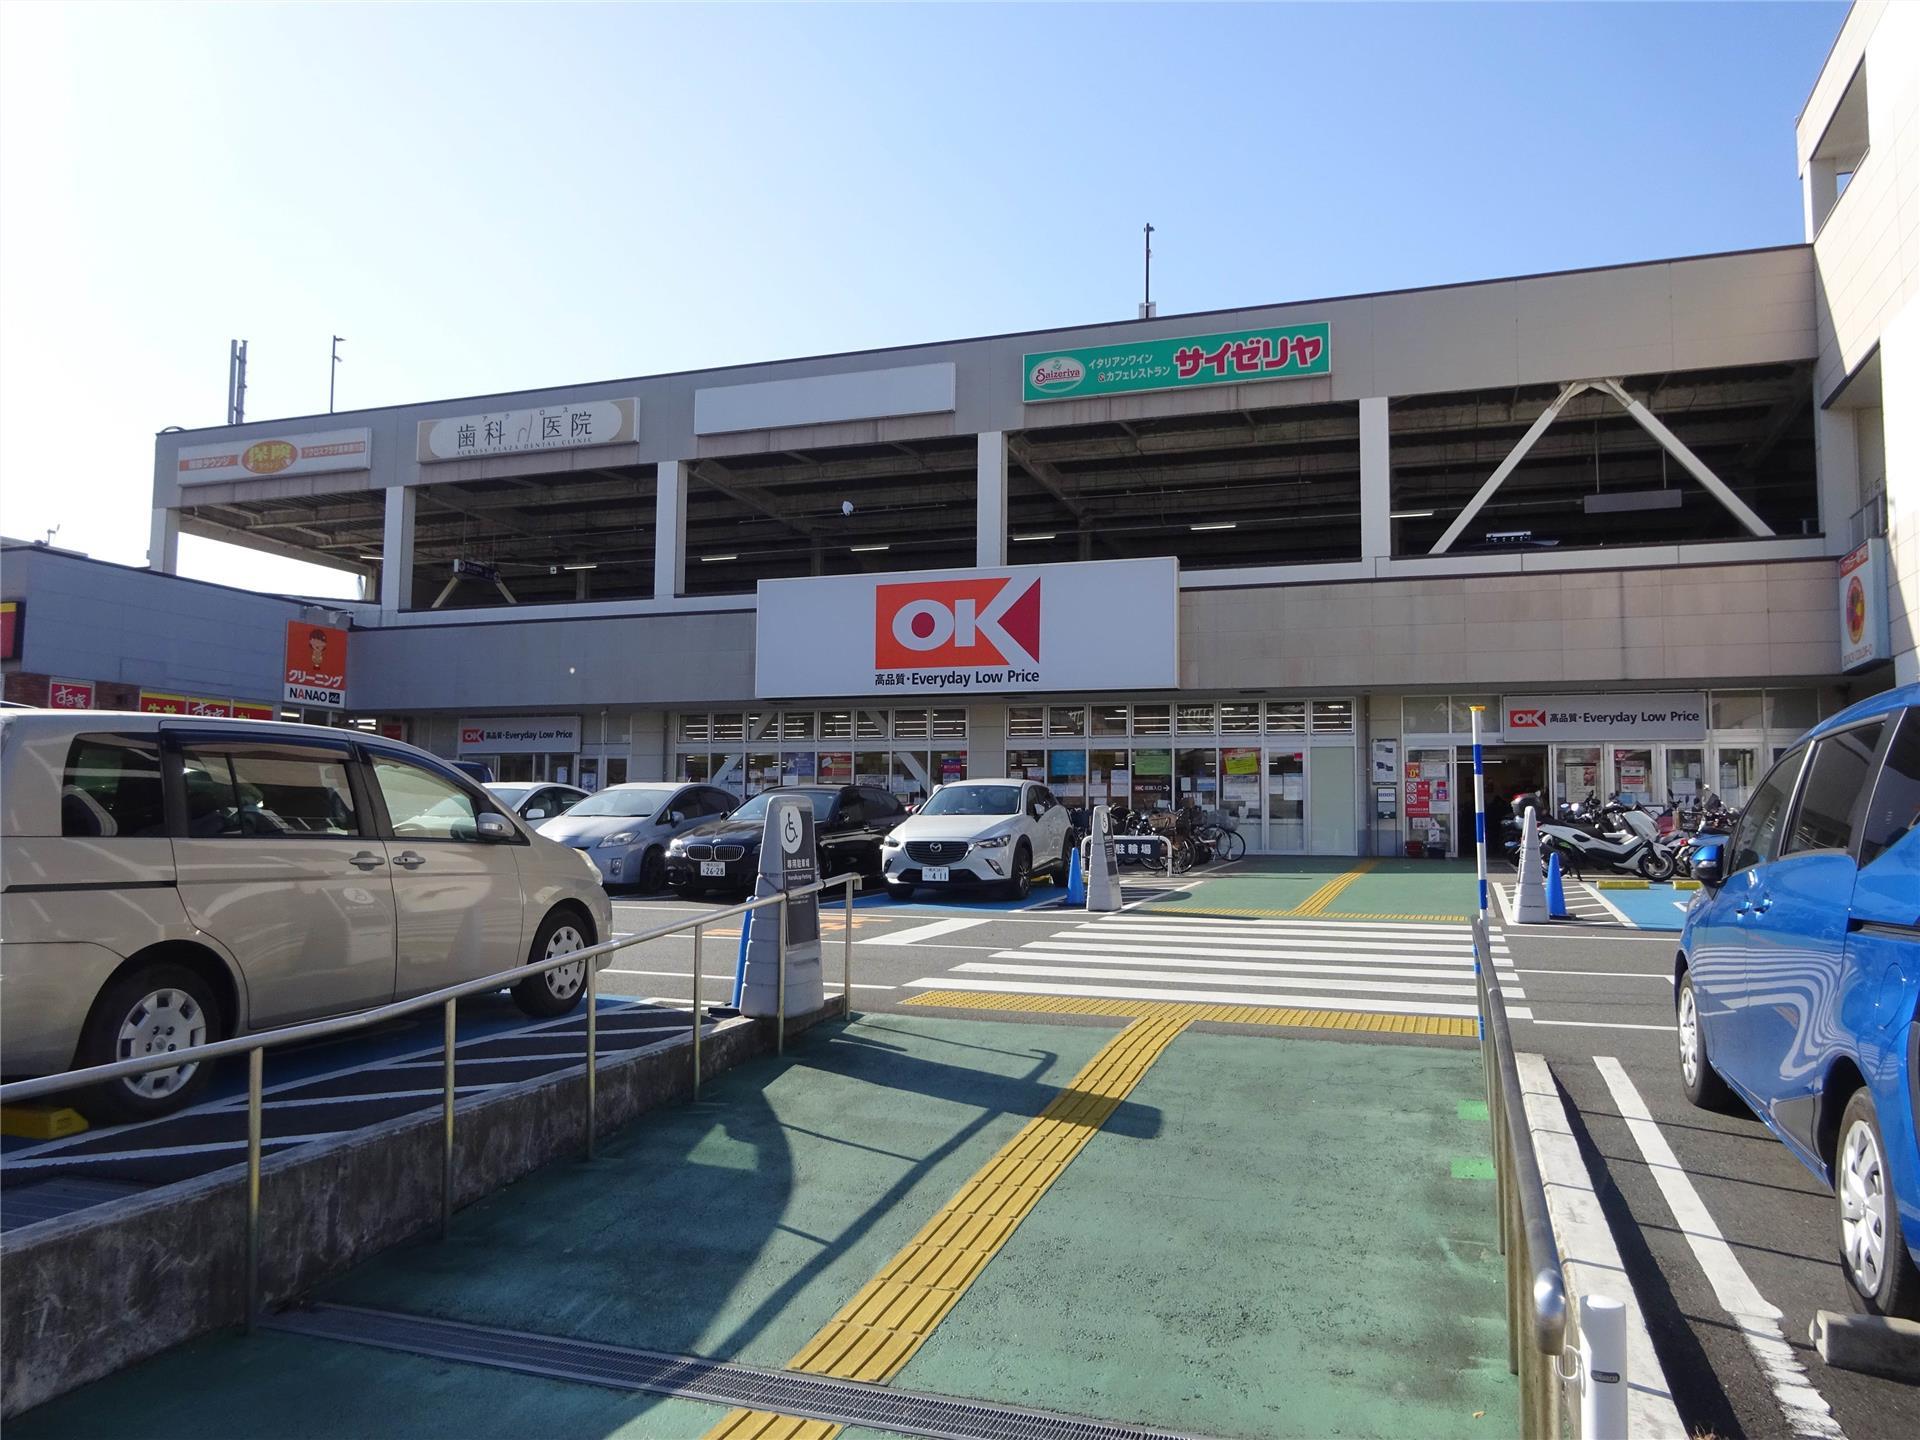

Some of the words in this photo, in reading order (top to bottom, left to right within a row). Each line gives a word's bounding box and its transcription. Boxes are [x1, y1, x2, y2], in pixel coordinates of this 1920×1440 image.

[1088, 354, 1153, 370] イタリアンワイン
[1174, 334, 1322, 379] サイゼリヤ
[1035, 367, 1081, 385] Saizeriya
[457, 420, 506, 450] 歯科
[542, 410, 592, 441] 医院
[889, 576, 1041, 667] OK
[288, 669, 343, 687] クリーニング
[975, 669, 1003, 684] Low
[1007, 668, 1040, 683] Price
[289, 687, 327, 702] NANAO
[1512, 710, 1546, 727] OK
[1641, 711, 1667, 722] Low
[1670, 711, 1699, 722] Price
[463, 729, 484, 742] OK
[539, 731, 554, 739] Low
[555, 730, 573, 739] Price
